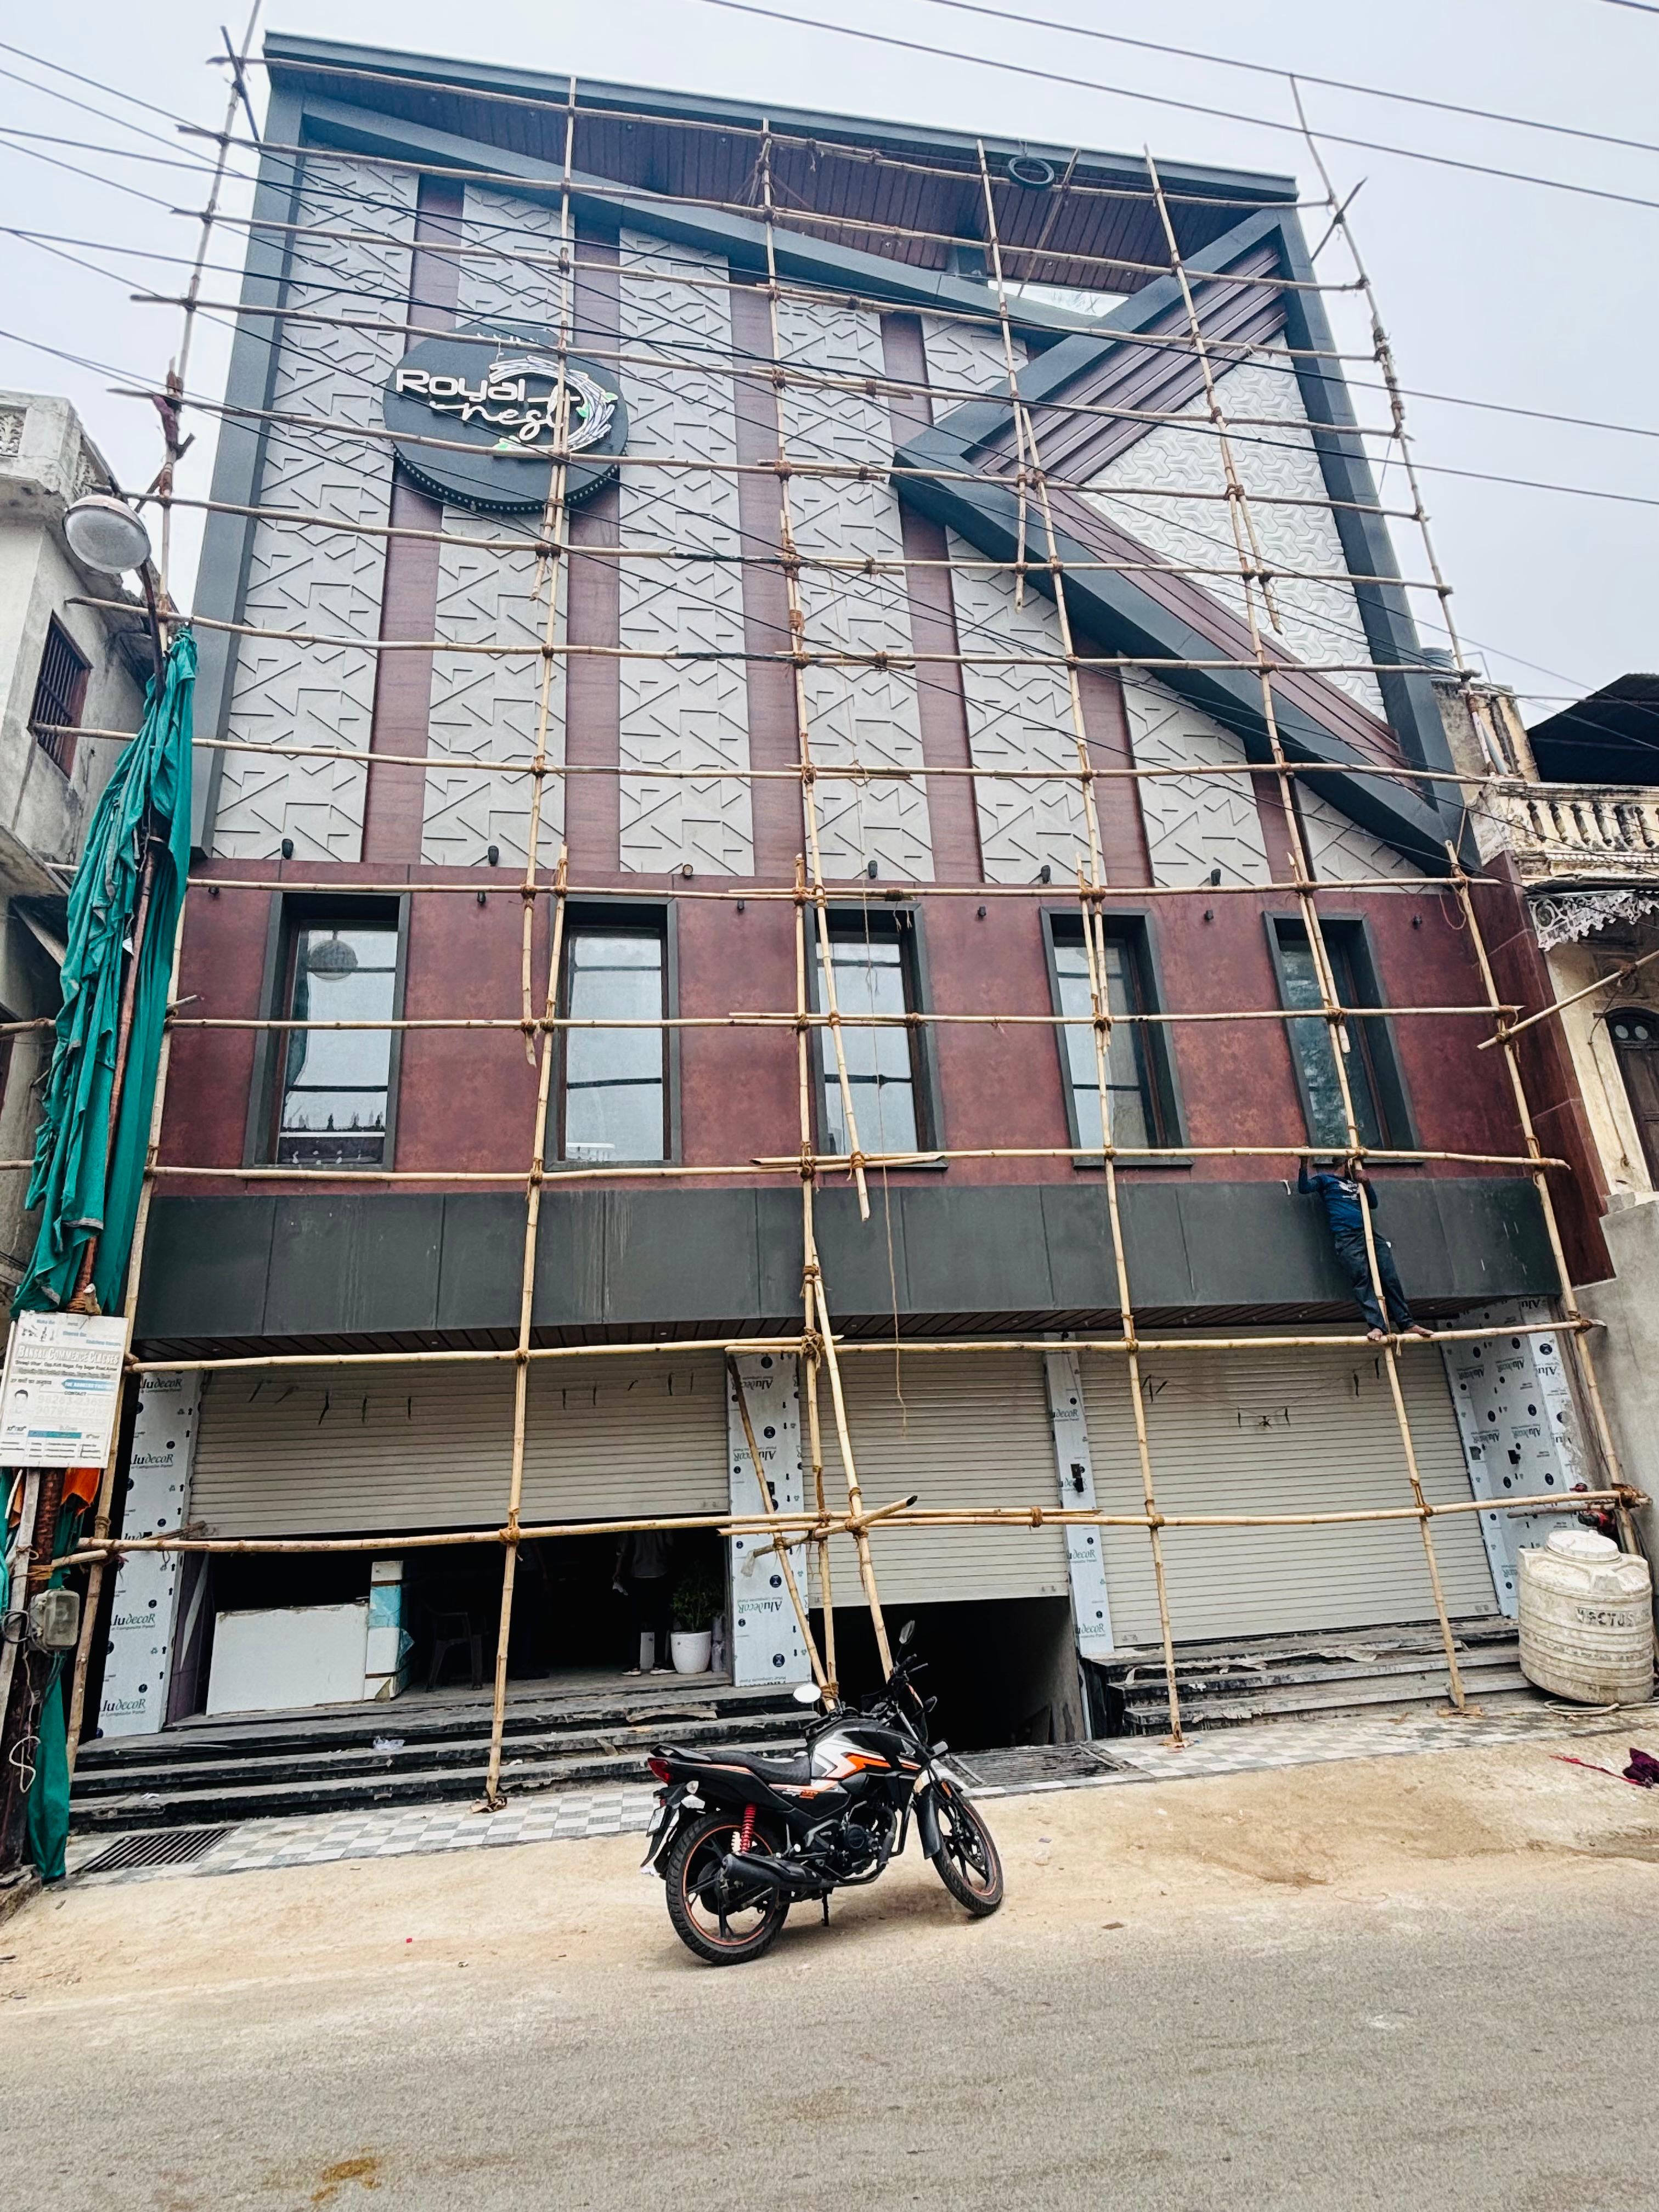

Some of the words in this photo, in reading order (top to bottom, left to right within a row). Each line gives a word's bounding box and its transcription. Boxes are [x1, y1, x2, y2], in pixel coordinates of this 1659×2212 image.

[396, 369, 526, 402] Royal
[18, 1345, 48, 1359] BANSAL
[48, 1347, 88, 1362] COMMERCE
[88, 1351, 119, 1365] CLASSES
[140, 1378, 183, 1389] ludecoR
[131, 1453, 174, 1465] ludecoR
[737, 1600, 783, 1614] AludecoR
[111, 1613, 155, 1626] ludecoR
[100, 1699, 146, 1712] ludecoR
